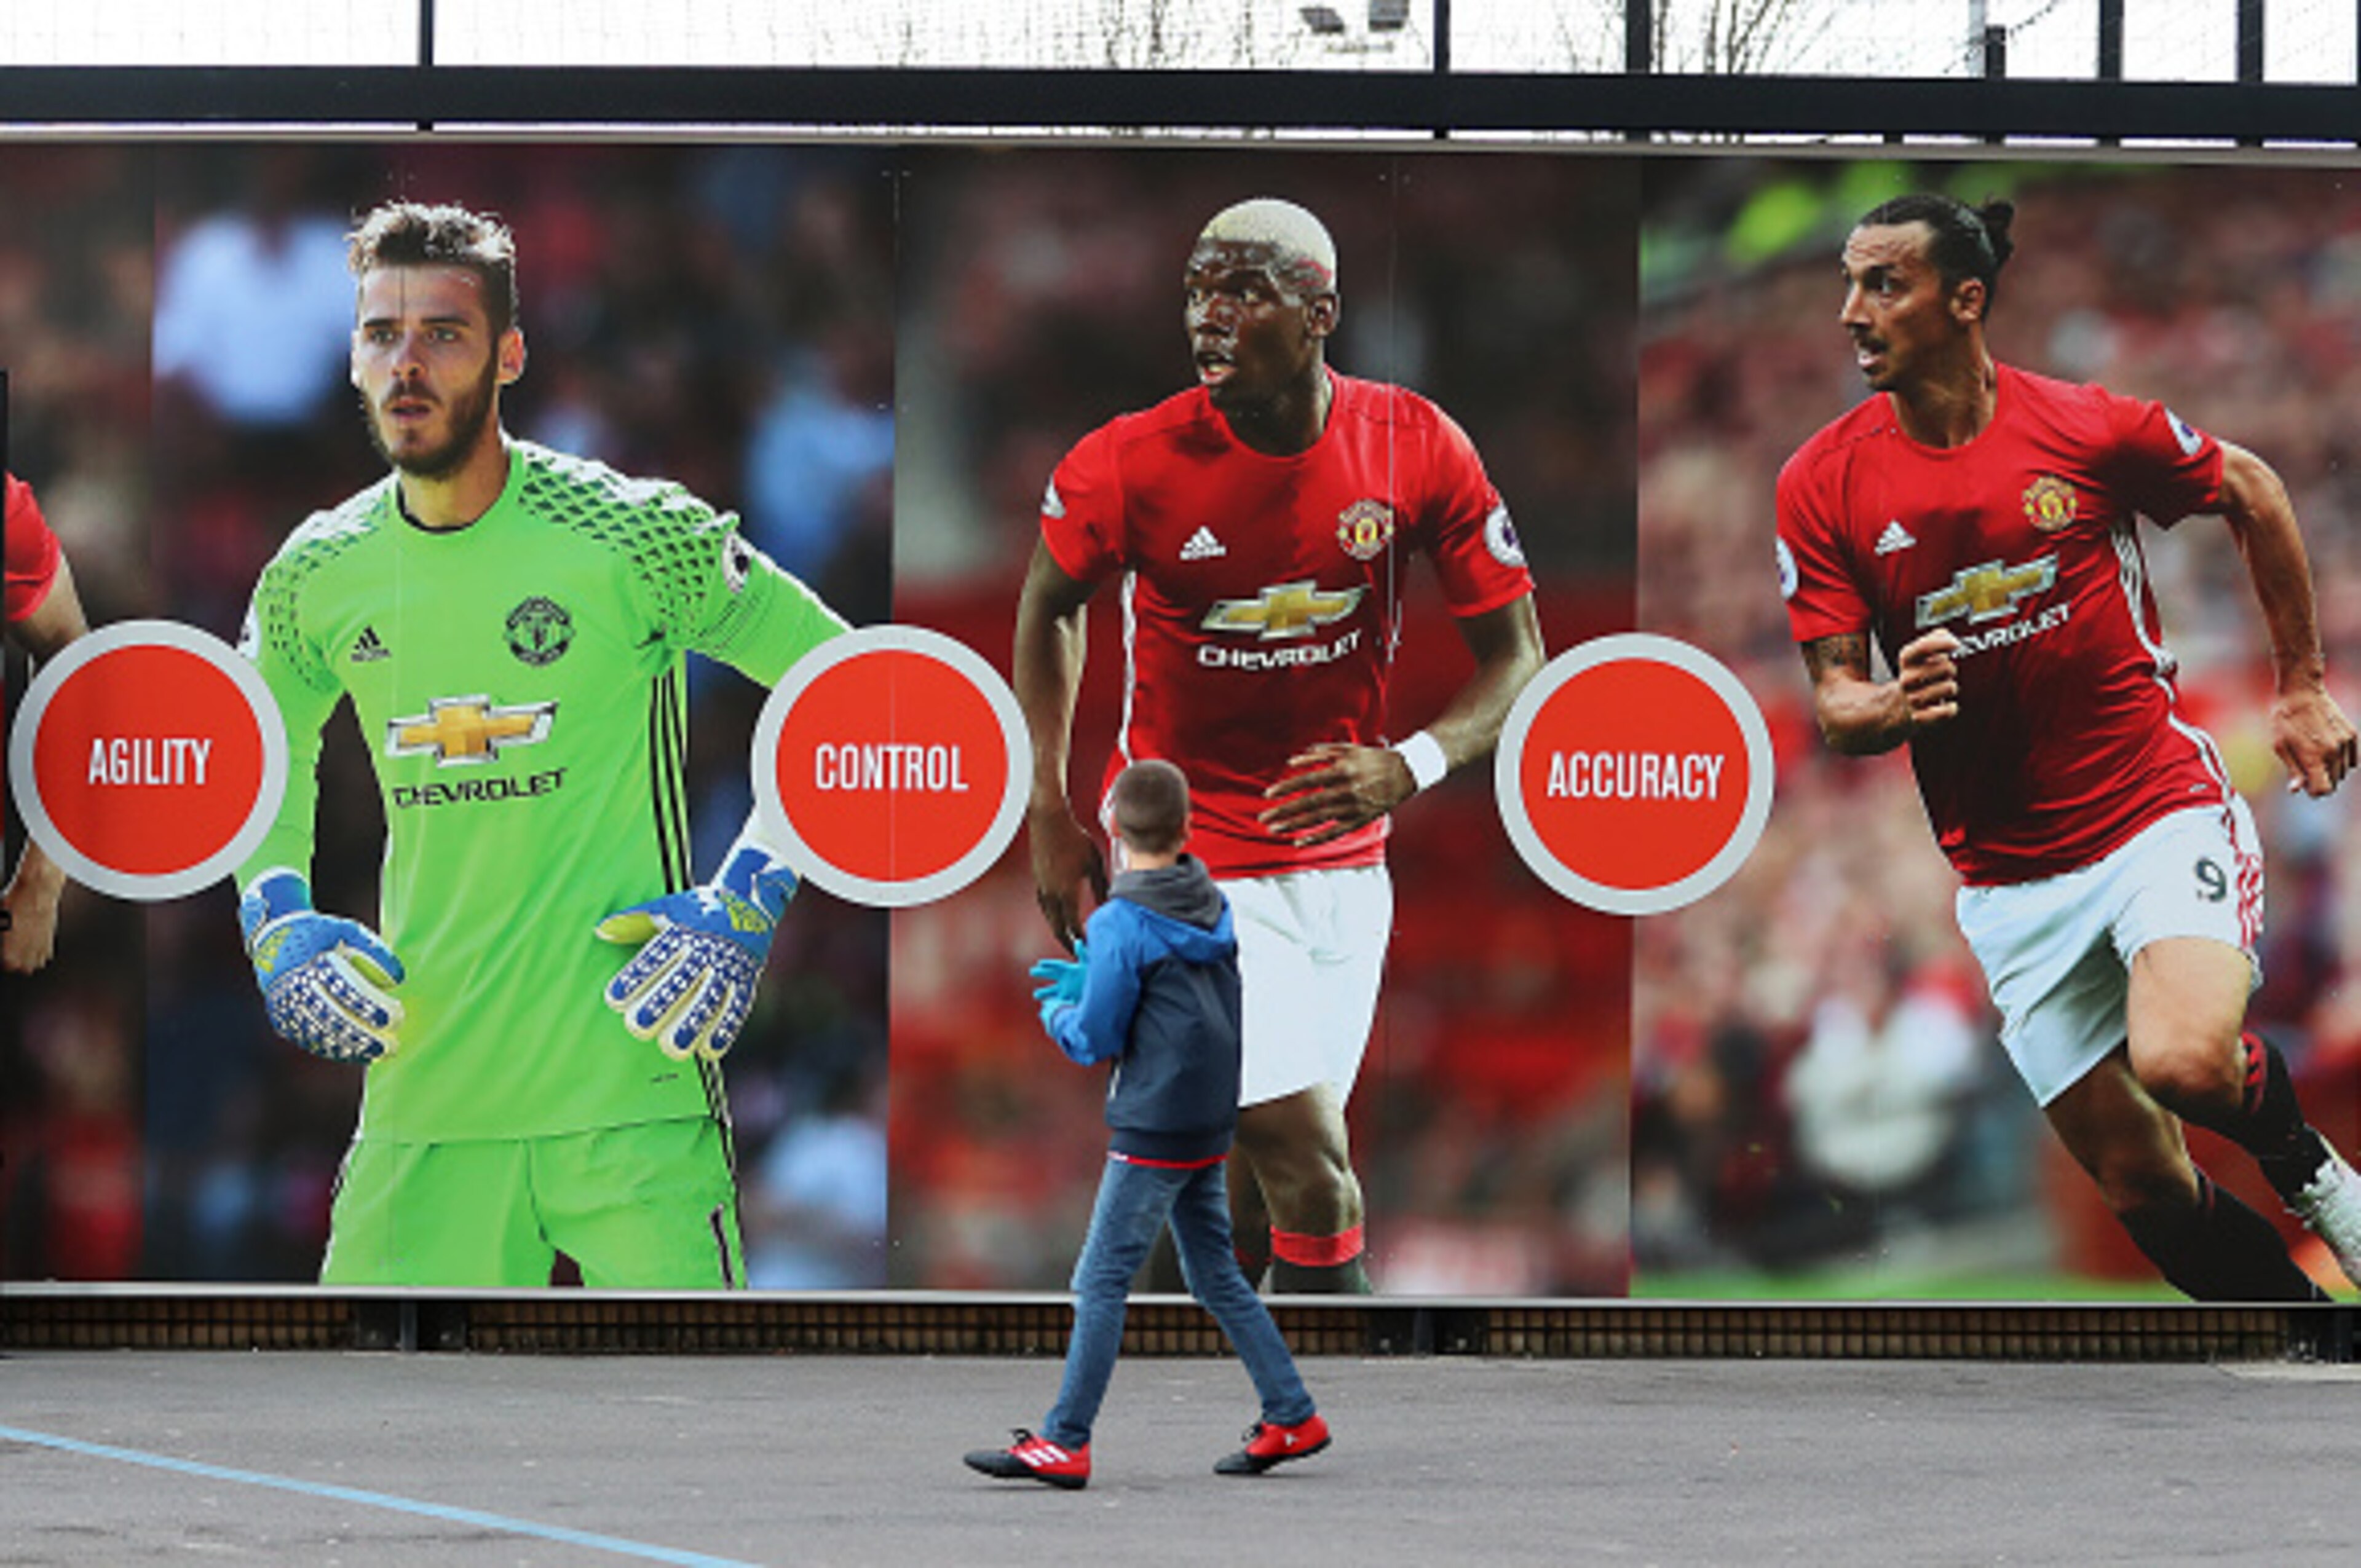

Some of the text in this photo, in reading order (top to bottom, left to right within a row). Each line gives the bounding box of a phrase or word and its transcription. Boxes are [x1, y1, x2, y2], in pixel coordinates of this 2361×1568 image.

[1196, 628, 1362, 671] CHEVROLET
[88, 738, 213, 785] AGILITY
[815, 742, 970, 792] CONTROL
[1547, 751, 1725, 800] ACCURACY
[392, 767, 568, 809] CHEVROLET
[2194, 856, 2228, 904] 9
